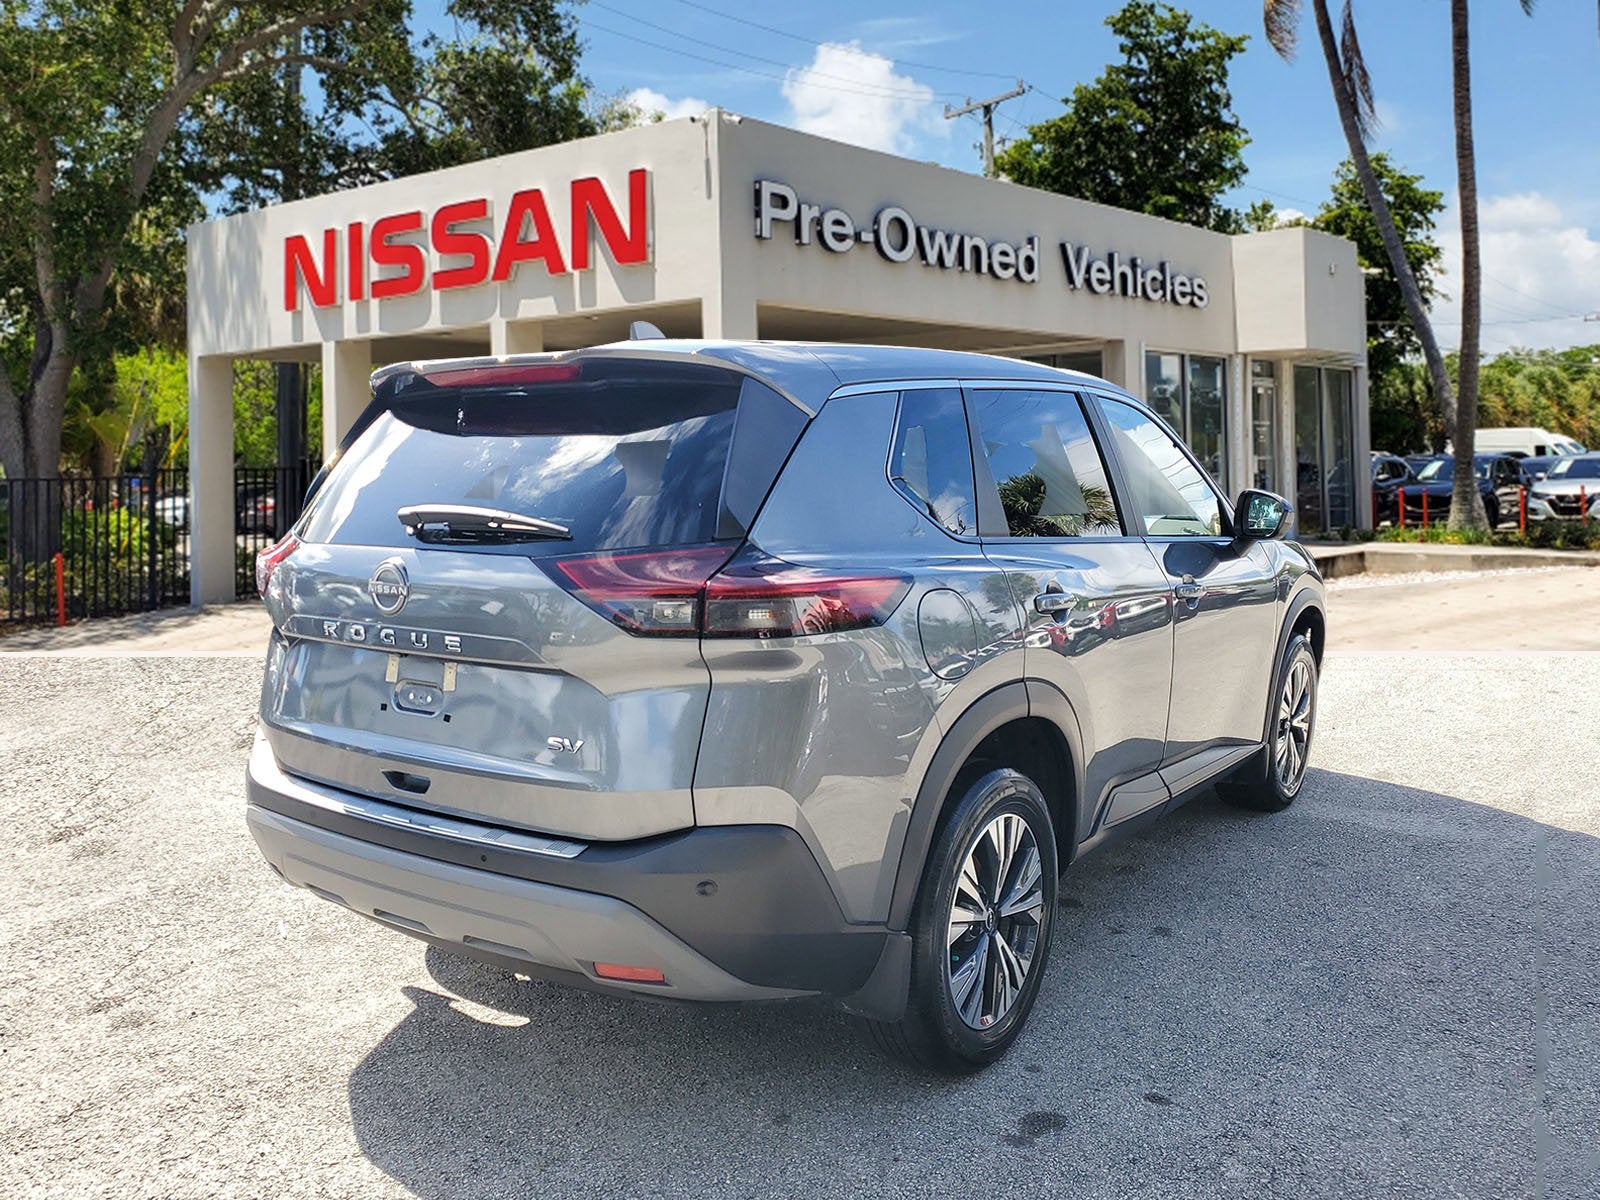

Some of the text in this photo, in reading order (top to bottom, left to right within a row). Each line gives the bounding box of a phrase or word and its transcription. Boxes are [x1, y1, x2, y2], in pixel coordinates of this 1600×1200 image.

[284, 168, 650, 312] NISSAN
[754, 180, 1209, 309] Pre-Owned Vehicles
[369, 584, 409, 596] NISSAN
[322, 620, 463, 653] ROGUE
[546, 736, 585, 755] SV
